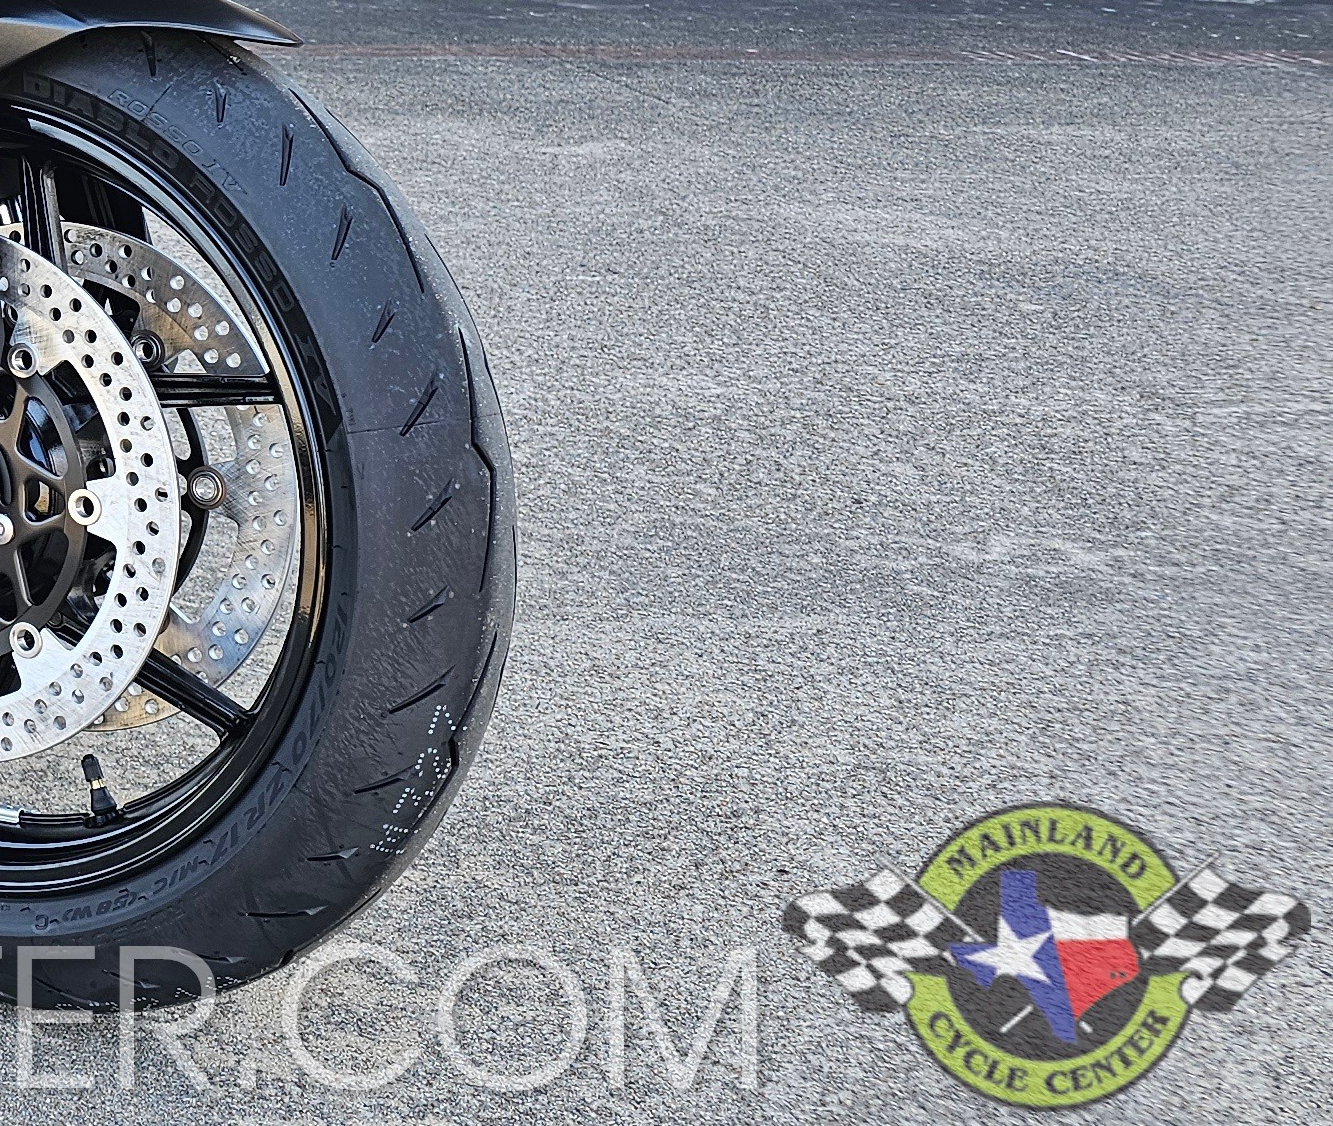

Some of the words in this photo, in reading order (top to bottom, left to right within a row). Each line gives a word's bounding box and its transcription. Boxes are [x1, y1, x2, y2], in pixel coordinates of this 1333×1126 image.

[23, 76, 181, 169] DIABLO
[188, 171, 295, 312] ROSSO
[107, 88, 202, 156] ROSSO
[201, 158, 248, 196] IV
